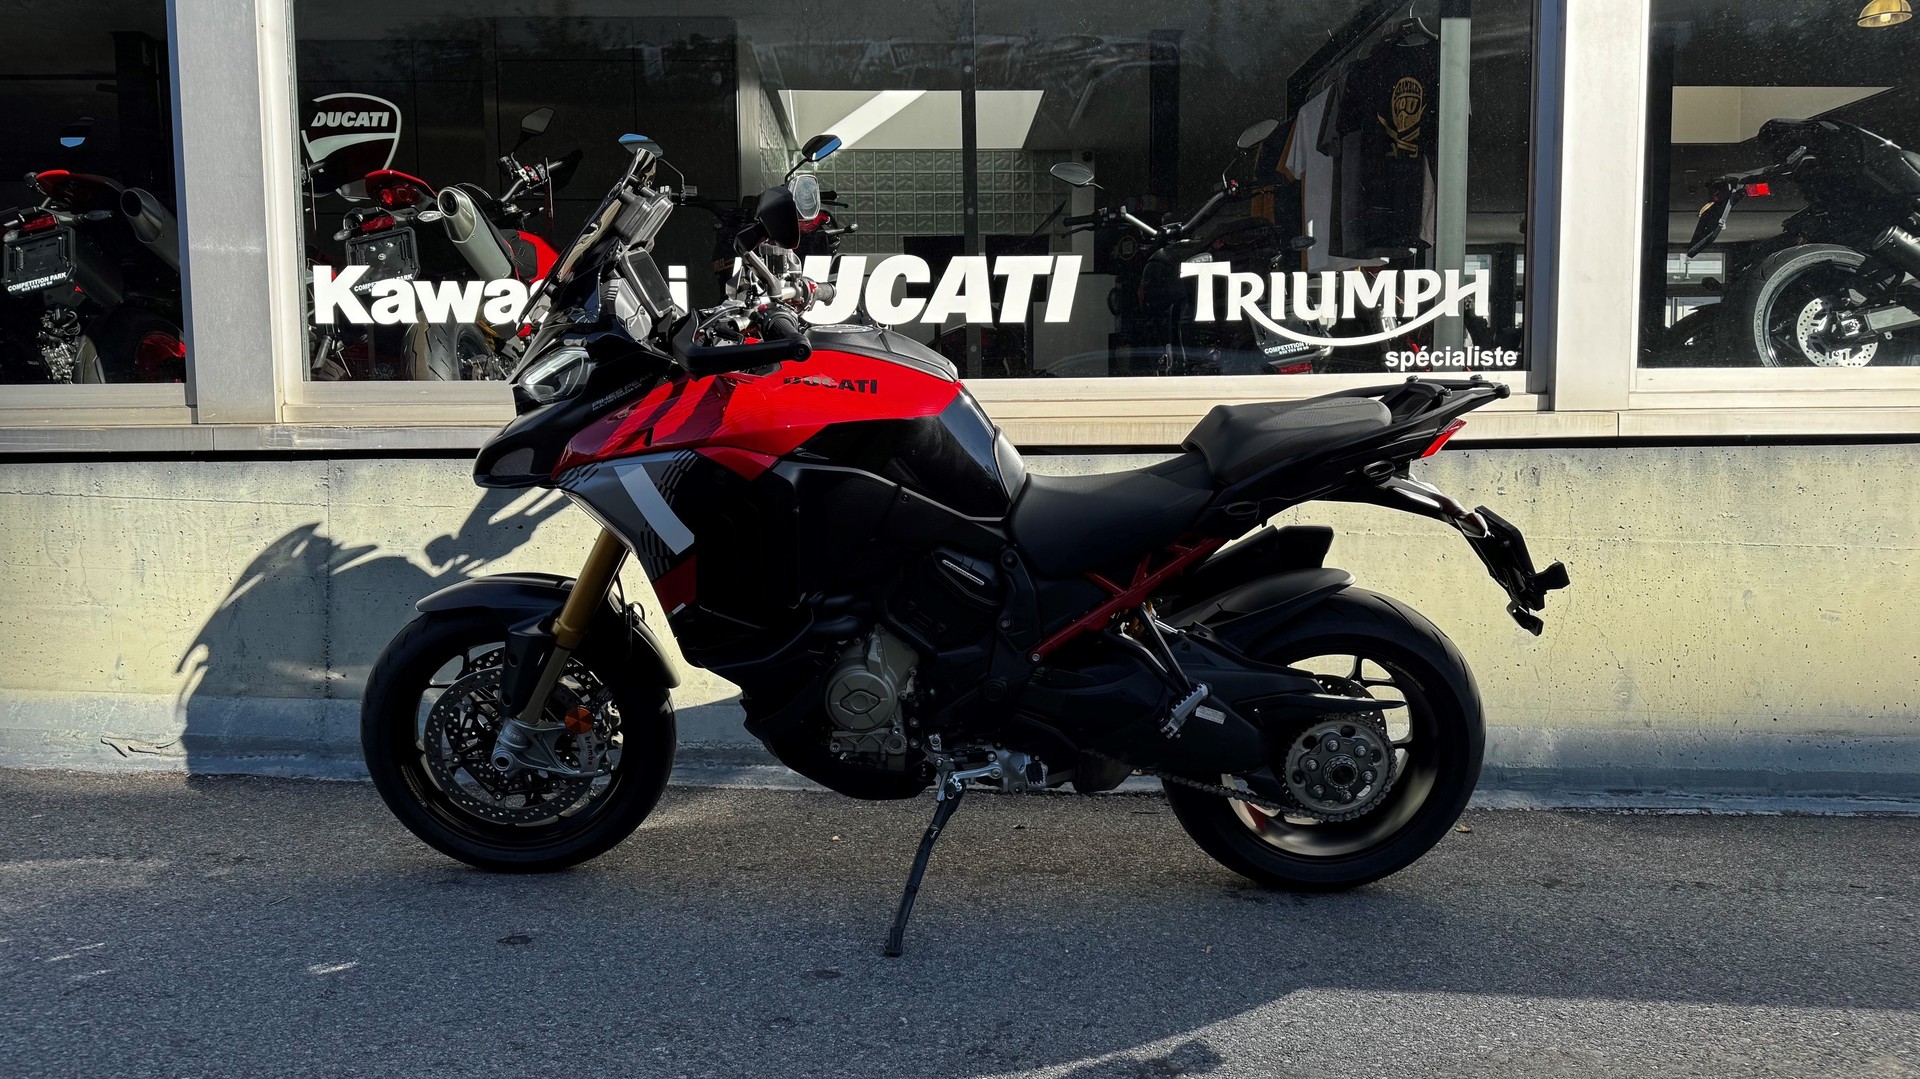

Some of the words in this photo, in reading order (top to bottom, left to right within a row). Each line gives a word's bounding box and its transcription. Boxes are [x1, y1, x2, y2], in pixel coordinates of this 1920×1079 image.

[311, 111, 389, 127] DUCATI
[7, 276, 49, 291] COMPETITION
[50, 272, 67, 280] PARK
[733, 254, 1082, 325] UCATI
[313, 265, 687, 325] Kawai
[1180, 261, 1490, 346] TRIUMPH
[1264, 342, 1304, 354] COMPETITION
[1385, 346, 1517, 371] spécialiste
[783, 375, 878, 394] DUCATI
[584, 735, 596, 766] brembo
